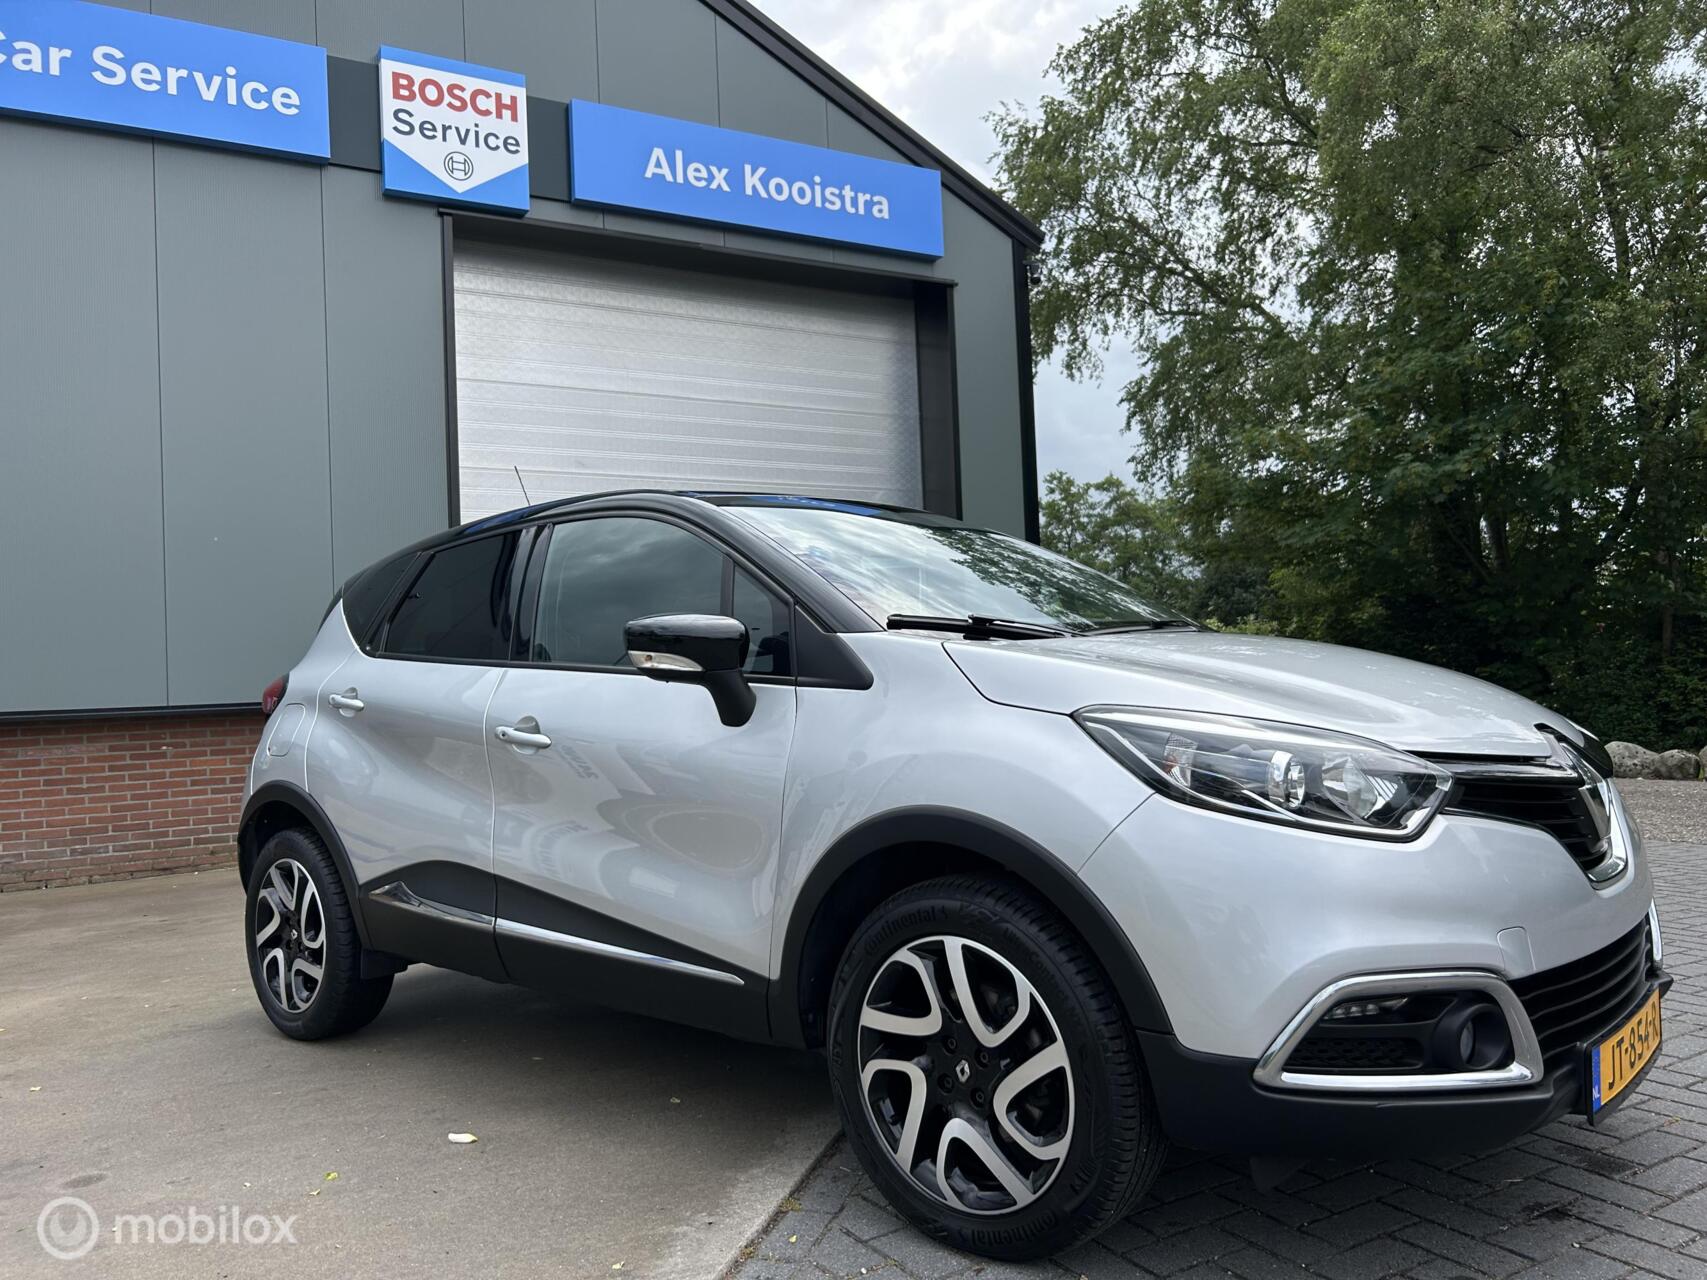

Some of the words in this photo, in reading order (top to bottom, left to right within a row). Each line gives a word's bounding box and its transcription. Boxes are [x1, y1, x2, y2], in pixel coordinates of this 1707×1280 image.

[91, 45, 301, 116] Service
[391, 71, 519, 123] BOSCH
[392, 108, 521, 155] Service
[644, 147, 731, 193] Alex
[744, 163, 890, 220] Kooistra
[1608, 1001, 1659, 1090] JT-854-R
[1592, 1085, 1601, 1101] NL
